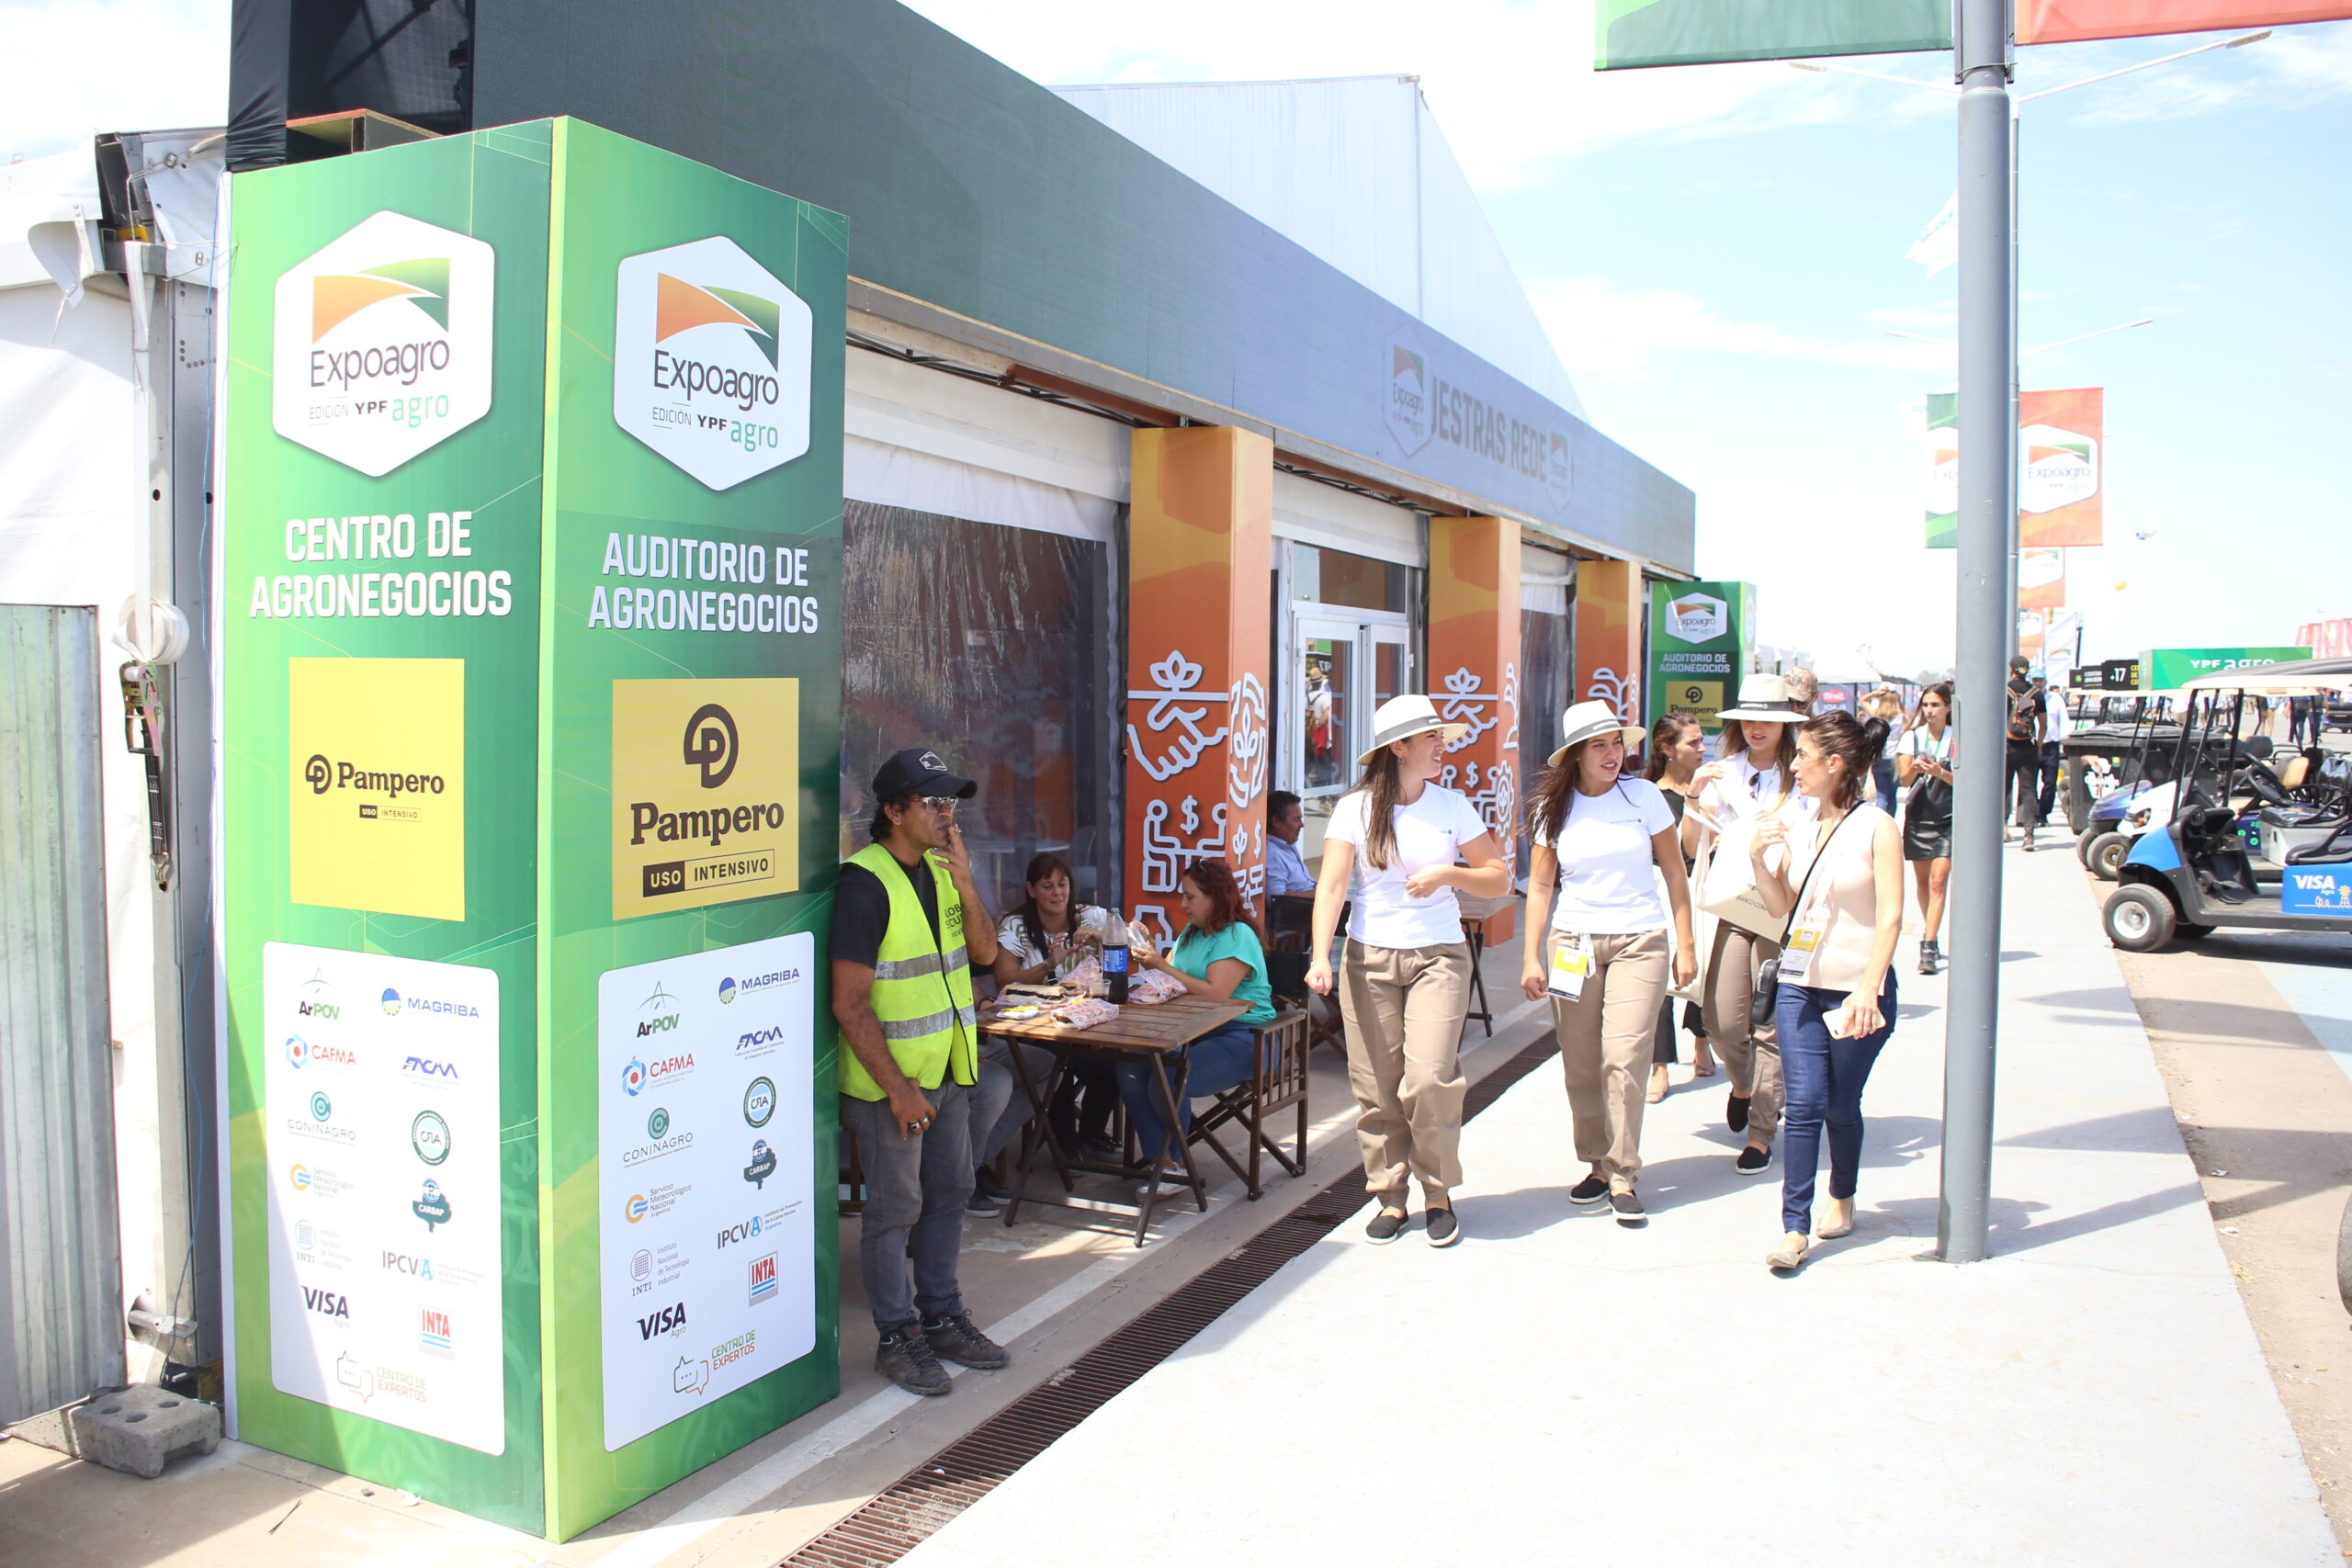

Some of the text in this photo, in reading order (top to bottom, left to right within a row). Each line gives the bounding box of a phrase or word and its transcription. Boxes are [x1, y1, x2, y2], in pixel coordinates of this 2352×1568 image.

[311, 340, 450, 391] Expoagro
[654, 349, 779, 412] Expoagro
[355, 400, 388, 415] YPF
[391, 394, 449, 428] agro
[652, 406, 778, 452] EDICIÓN YPF agro
[2028, 466, 2091, 479] Expoagro
[285, 510, 473, 561] CENTRO DE
[601, 532, 809, 588] AUDITORIO DE
[249, 570, 513, 619] AGRONEGOCIOS
[588, 586, 820, 635] AGRONEGOCIOS
[1659, 663, 1731, 673] AGRONEGOCIOS
[1662, 653, 1728, 663] AUDITORIO DE
[2190, 660, 2222, 669] YPF
[337, 761, 445, 798] Pampero
[362, 807, 418, 819] USO INTENSIVO
[630, 801, 785, 846] Pampero
[650, 858, 768, 888] USO INTENSIVO
[2291, 874, 2335, 889] VISA
[741, 967, 800, 990] MAGRIBA
[299, 1000, 340, 1021] ArPOV
[407, 997, 480, 1019] MAGRIBA
[637, 1013, 680, 1038] ArPOV
[311, 1044, 356, 1066] CAFMA
[650, 1053, 695, 1078] CAFMA
[287, 1118, 356, 1141] CONINAGRO
[623, 1132, 694, 1163] CONINAGRO
[749, 1161, 771, 1176] CARBAP
[650, 1183, 674, 1196] Servicio
[650, 1184, 692, 1203] Meteorológico
[418, 1203, 445, 1217] CARBAP
[650, 1198, 676, 1212] Nacional
[717, 1215, 763, 1250] IPCVA
[296, 1251, 315, 1264] INTI
[657, 1242, 678, 1255] Instituto
[657, 1252, 679, 1265] Nacional
[382, 1250, 435, 1280] IPCVA
[751, 1256, 775, 1286] INTA
[632, 1281, 652, 1297] INTI
[658, 1271, 681, 1286] Industrial
[300, 1285, 349, 1319] VISA
[422, 1308, 451, 1338] INTA
[635, 1302, 687, 1341] VISA
[671, 1326, 686, 1339] Agro
[711, 1329, 756, 1359] CENTRO DE
[712, 1341, 755, 1371] EXPERTOS
[377, 1366, 427, 1390] CENTRO DE
[379, 1379, 426, 1402] EXPERTOS
